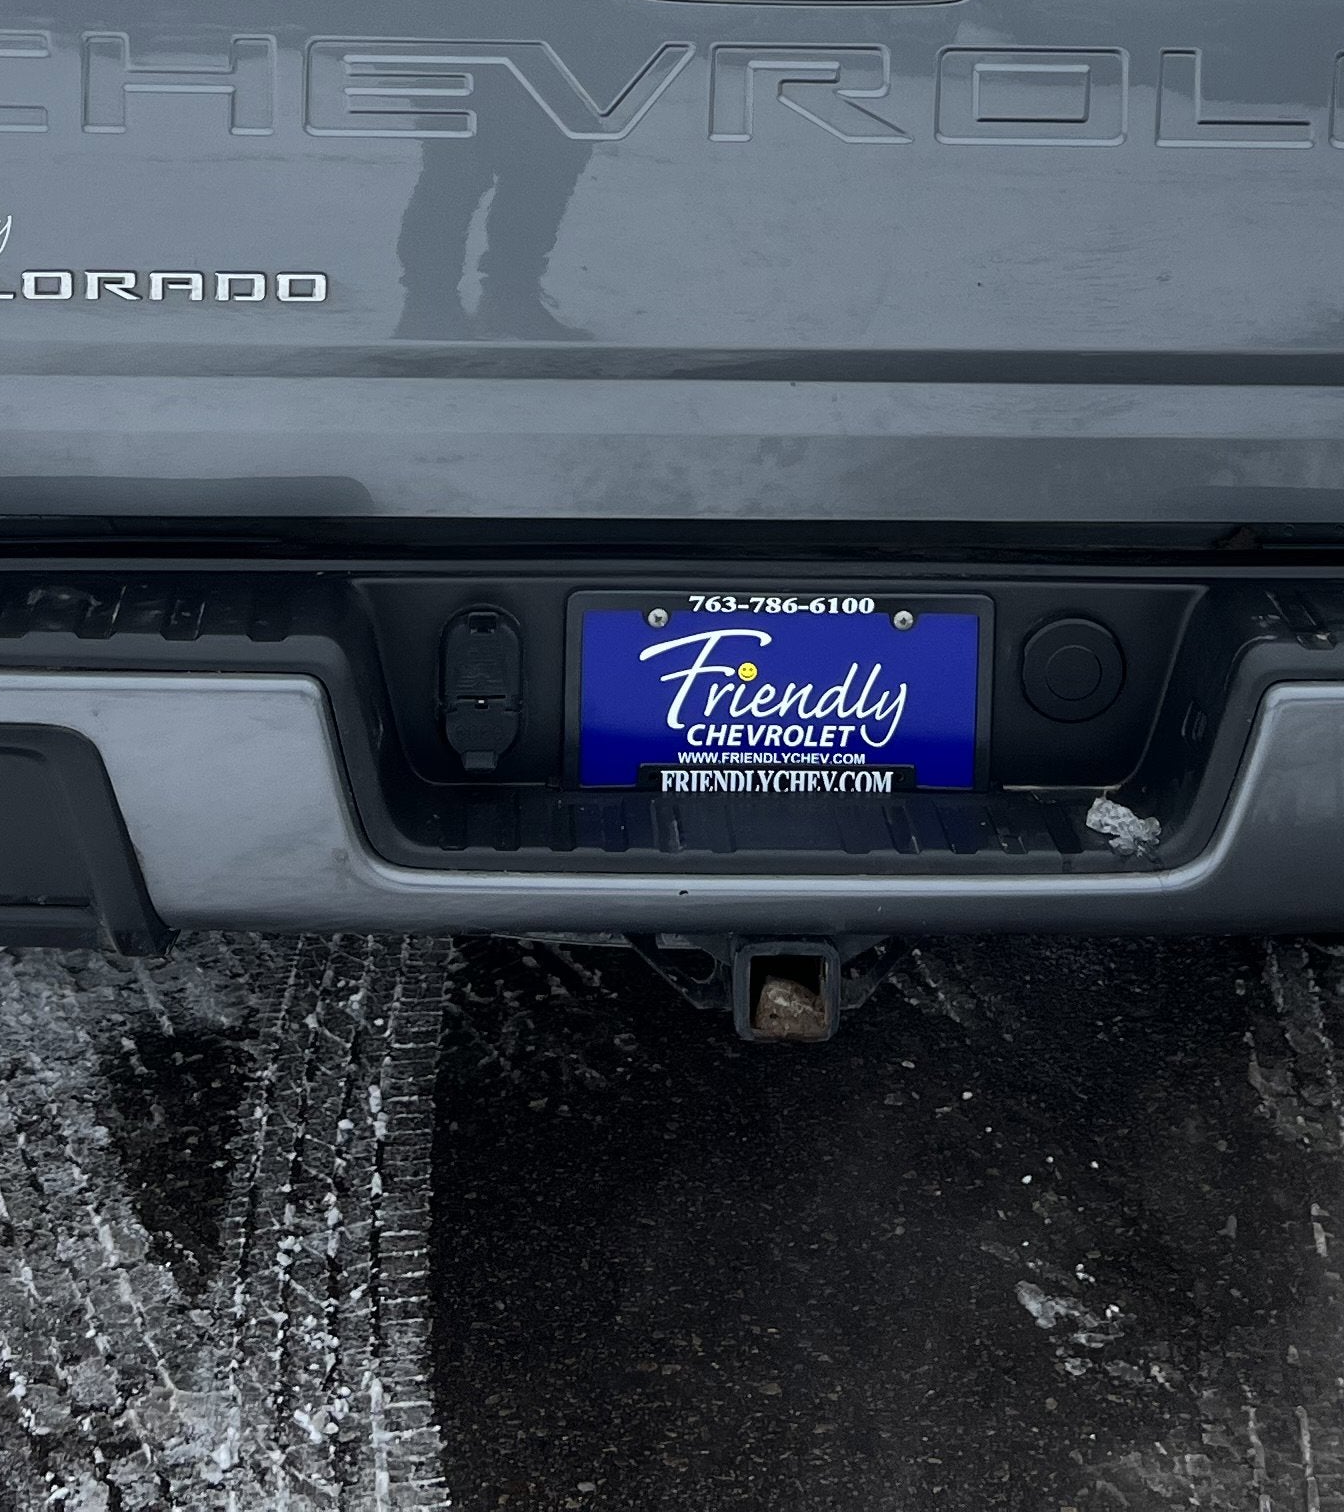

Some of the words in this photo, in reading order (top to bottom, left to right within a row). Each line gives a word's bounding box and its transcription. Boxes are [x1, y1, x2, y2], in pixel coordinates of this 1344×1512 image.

[688, 595, 875, 615] 763-786-6100
[639, 628, 907, 748] Friendly
[686, 723, 856, 748] CHEVROLET
[677, 751, 866, 766] WWW.FRIENDLYCHEV.COM
[660, 770, 894, 793] FRIENDLYCHEV.COM
